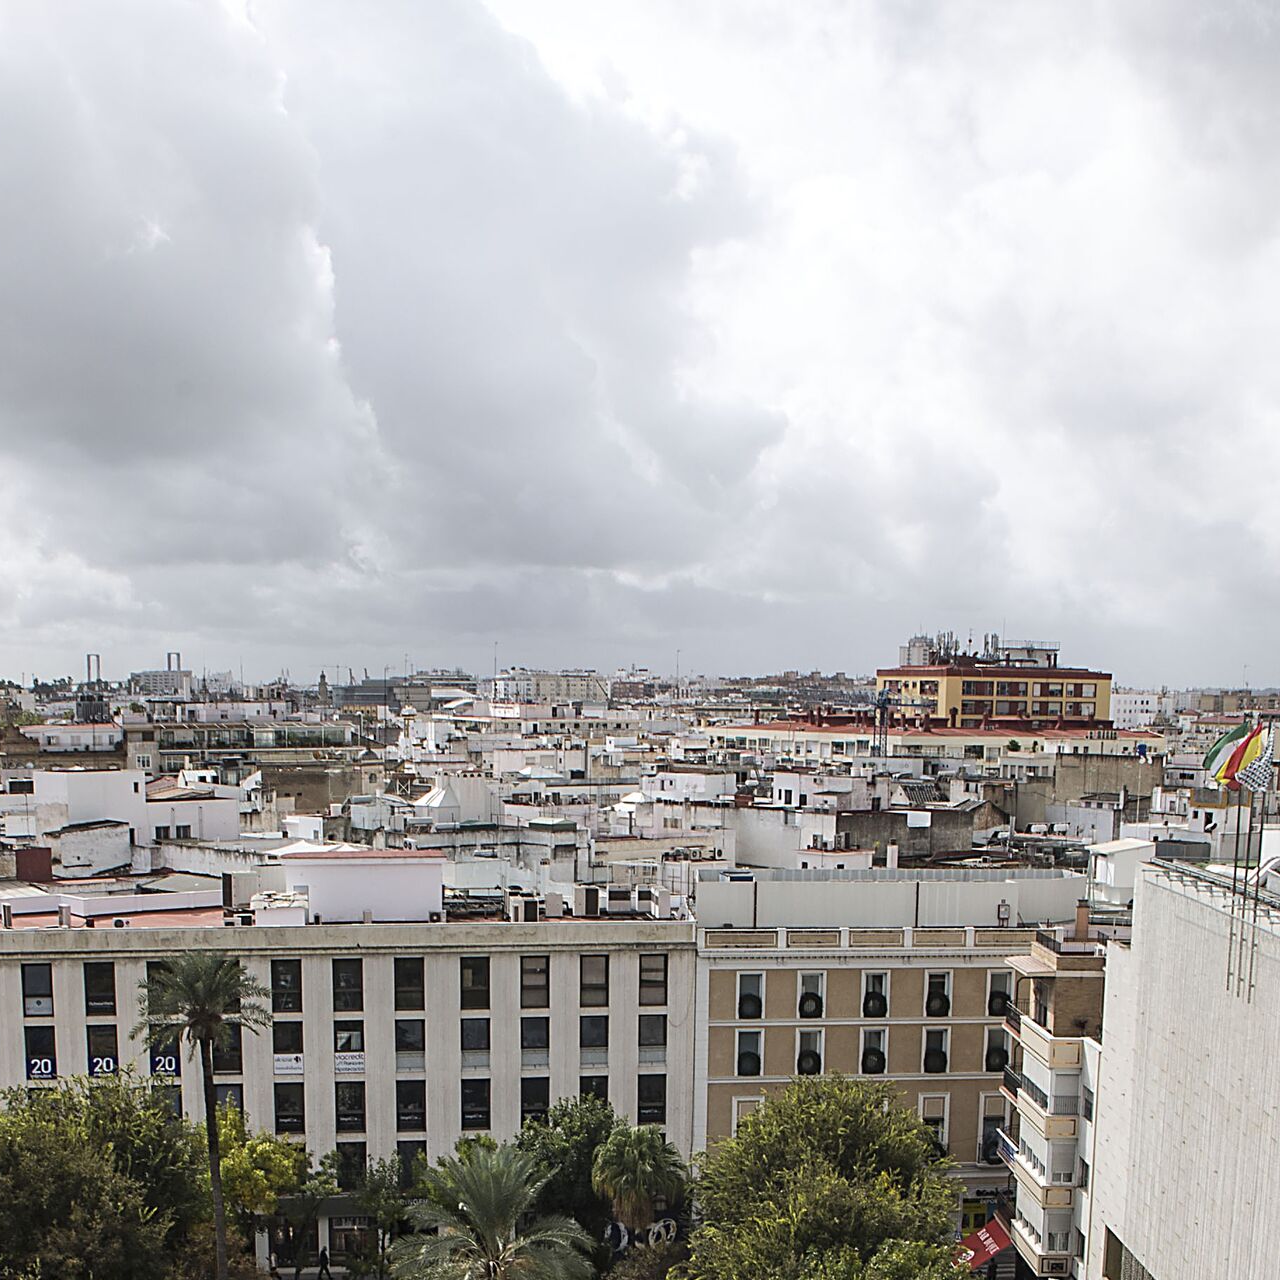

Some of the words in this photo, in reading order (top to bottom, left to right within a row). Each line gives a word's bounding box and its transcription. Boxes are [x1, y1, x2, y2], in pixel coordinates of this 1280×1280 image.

[31, 1058, 52, 1074] 20
[92, 1057, 114, 1073] 20
[155, 1056, 176, 1071] 20
